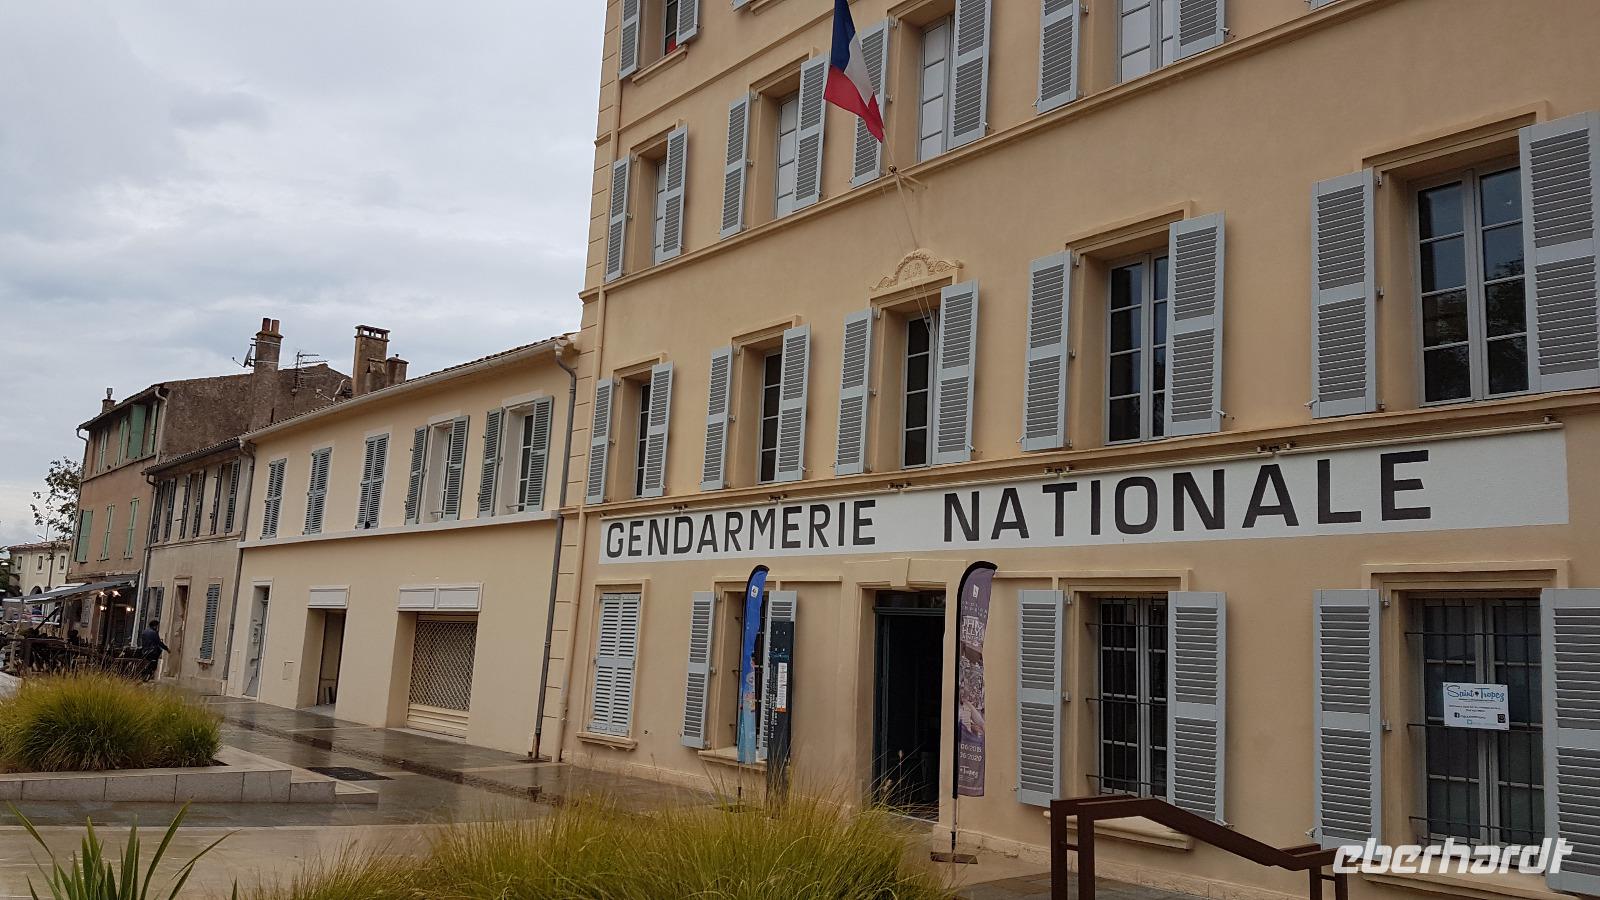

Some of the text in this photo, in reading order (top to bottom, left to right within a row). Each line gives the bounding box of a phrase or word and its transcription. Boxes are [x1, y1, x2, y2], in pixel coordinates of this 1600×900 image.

[607, 449, 1432, 558] GENDARMERIE NATIONALE
[1447, 685, 1505, 702] Saint Tropez
